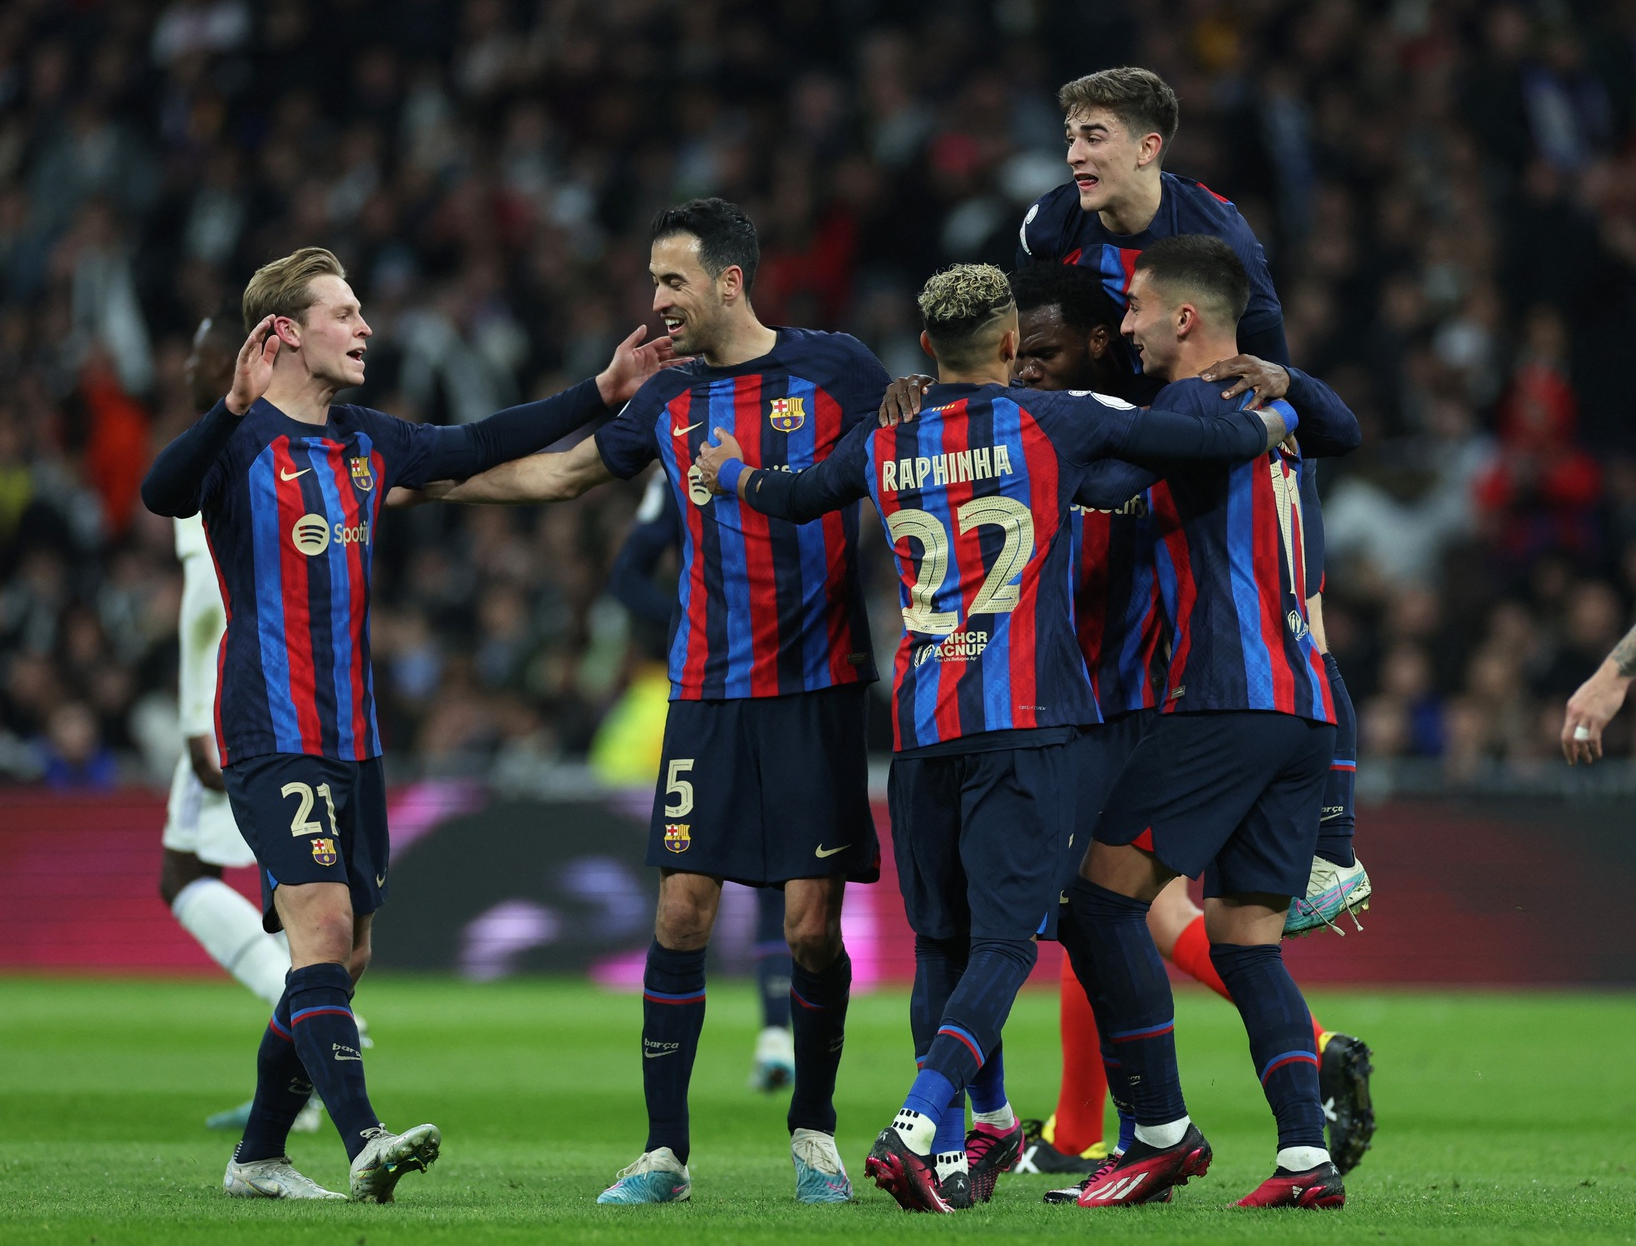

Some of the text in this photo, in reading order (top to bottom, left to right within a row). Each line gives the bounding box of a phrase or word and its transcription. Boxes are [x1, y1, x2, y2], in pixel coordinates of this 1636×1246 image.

[883, 444, 1013, 492] RAPHINHA
[886, 495, 1035, 635] 22
[944, 631, 987, 644] NHCR
[280, 781, 339, 838] 21
[664, 758, 695, 818] 5
[644, 1038, 679, 1050] barça
